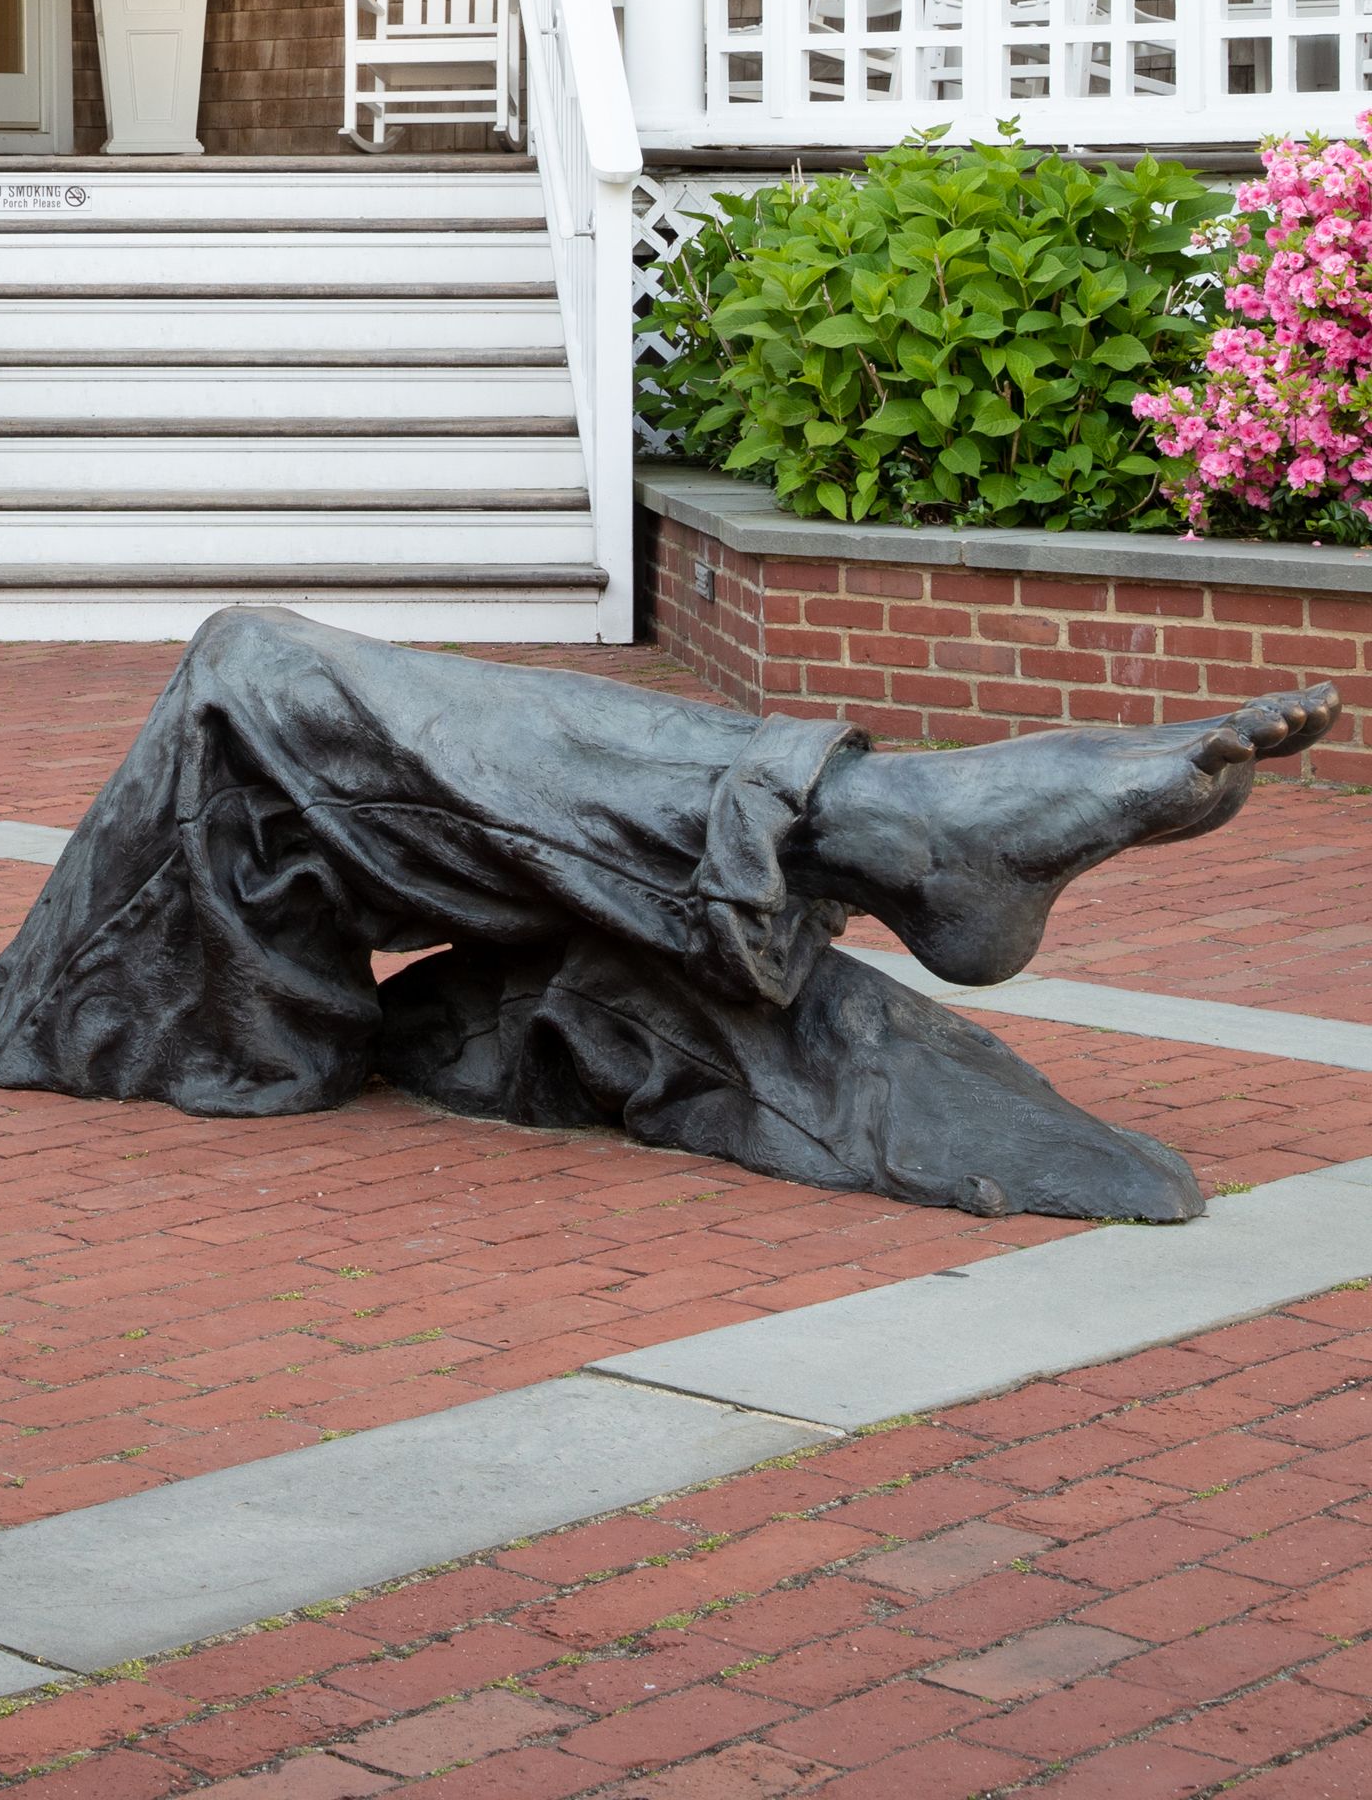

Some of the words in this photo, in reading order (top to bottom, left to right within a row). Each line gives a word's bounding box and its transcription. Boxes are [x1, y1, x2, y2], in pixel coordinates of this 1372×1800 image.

[8, 185, 61, 197] SMOKING
[3, 198, 28, 208] Porch
[33, 198, 61, 208] Please
